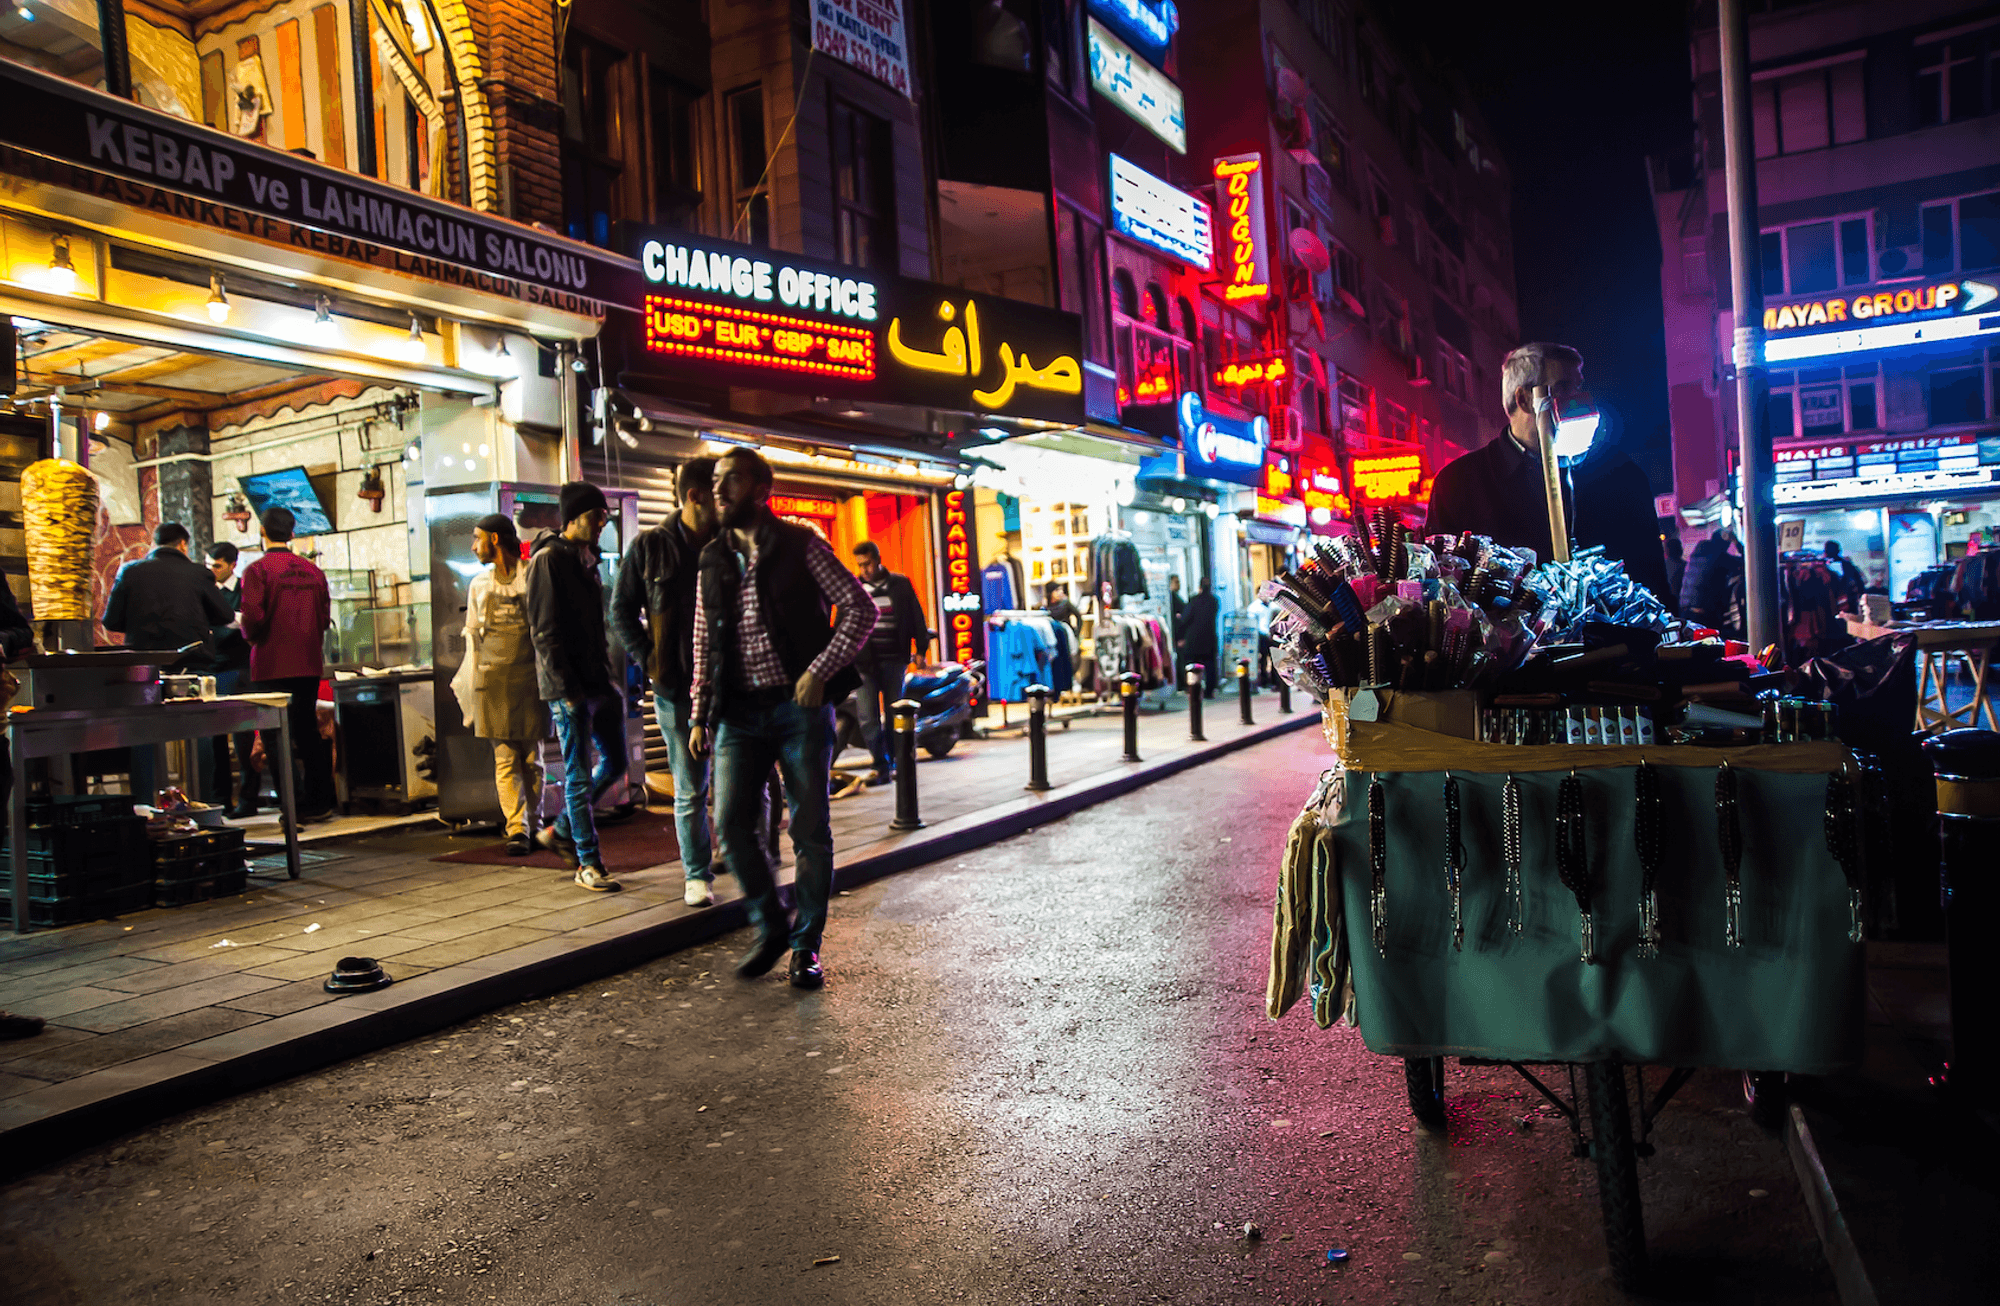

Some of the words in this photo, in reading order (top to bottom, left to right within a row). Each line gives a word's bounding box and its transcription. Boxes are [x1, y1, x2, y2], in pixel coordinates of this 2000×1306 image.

[857, 0, 893, 37] RENT
[86, 112, 236, 194] KEBAP
[248, 171, 290, 211] ve
[301, 177, 477, 262] LAHMACUN
[486, 233, 588, 289] SALONU
[290, 225, 380, 264] KEBAP
[395, 253, 521, 300] LAHMACUN
[527, 283, 605, 318] SALONU
[642, 240, 774, 301] CHANGE
[778, 266, 878, 321] OFFICE
[1852, 283, 1960, 319] GROUP
[653, 311, 701, 338] USD
[715, 320, 763, 349] EUR
[773, 329, 814, 356] GBP
[827, 338, 866, 362] SAR
[887, 299, 1083, 409] صراف
[945, 490, 971, 594] CHANGE
